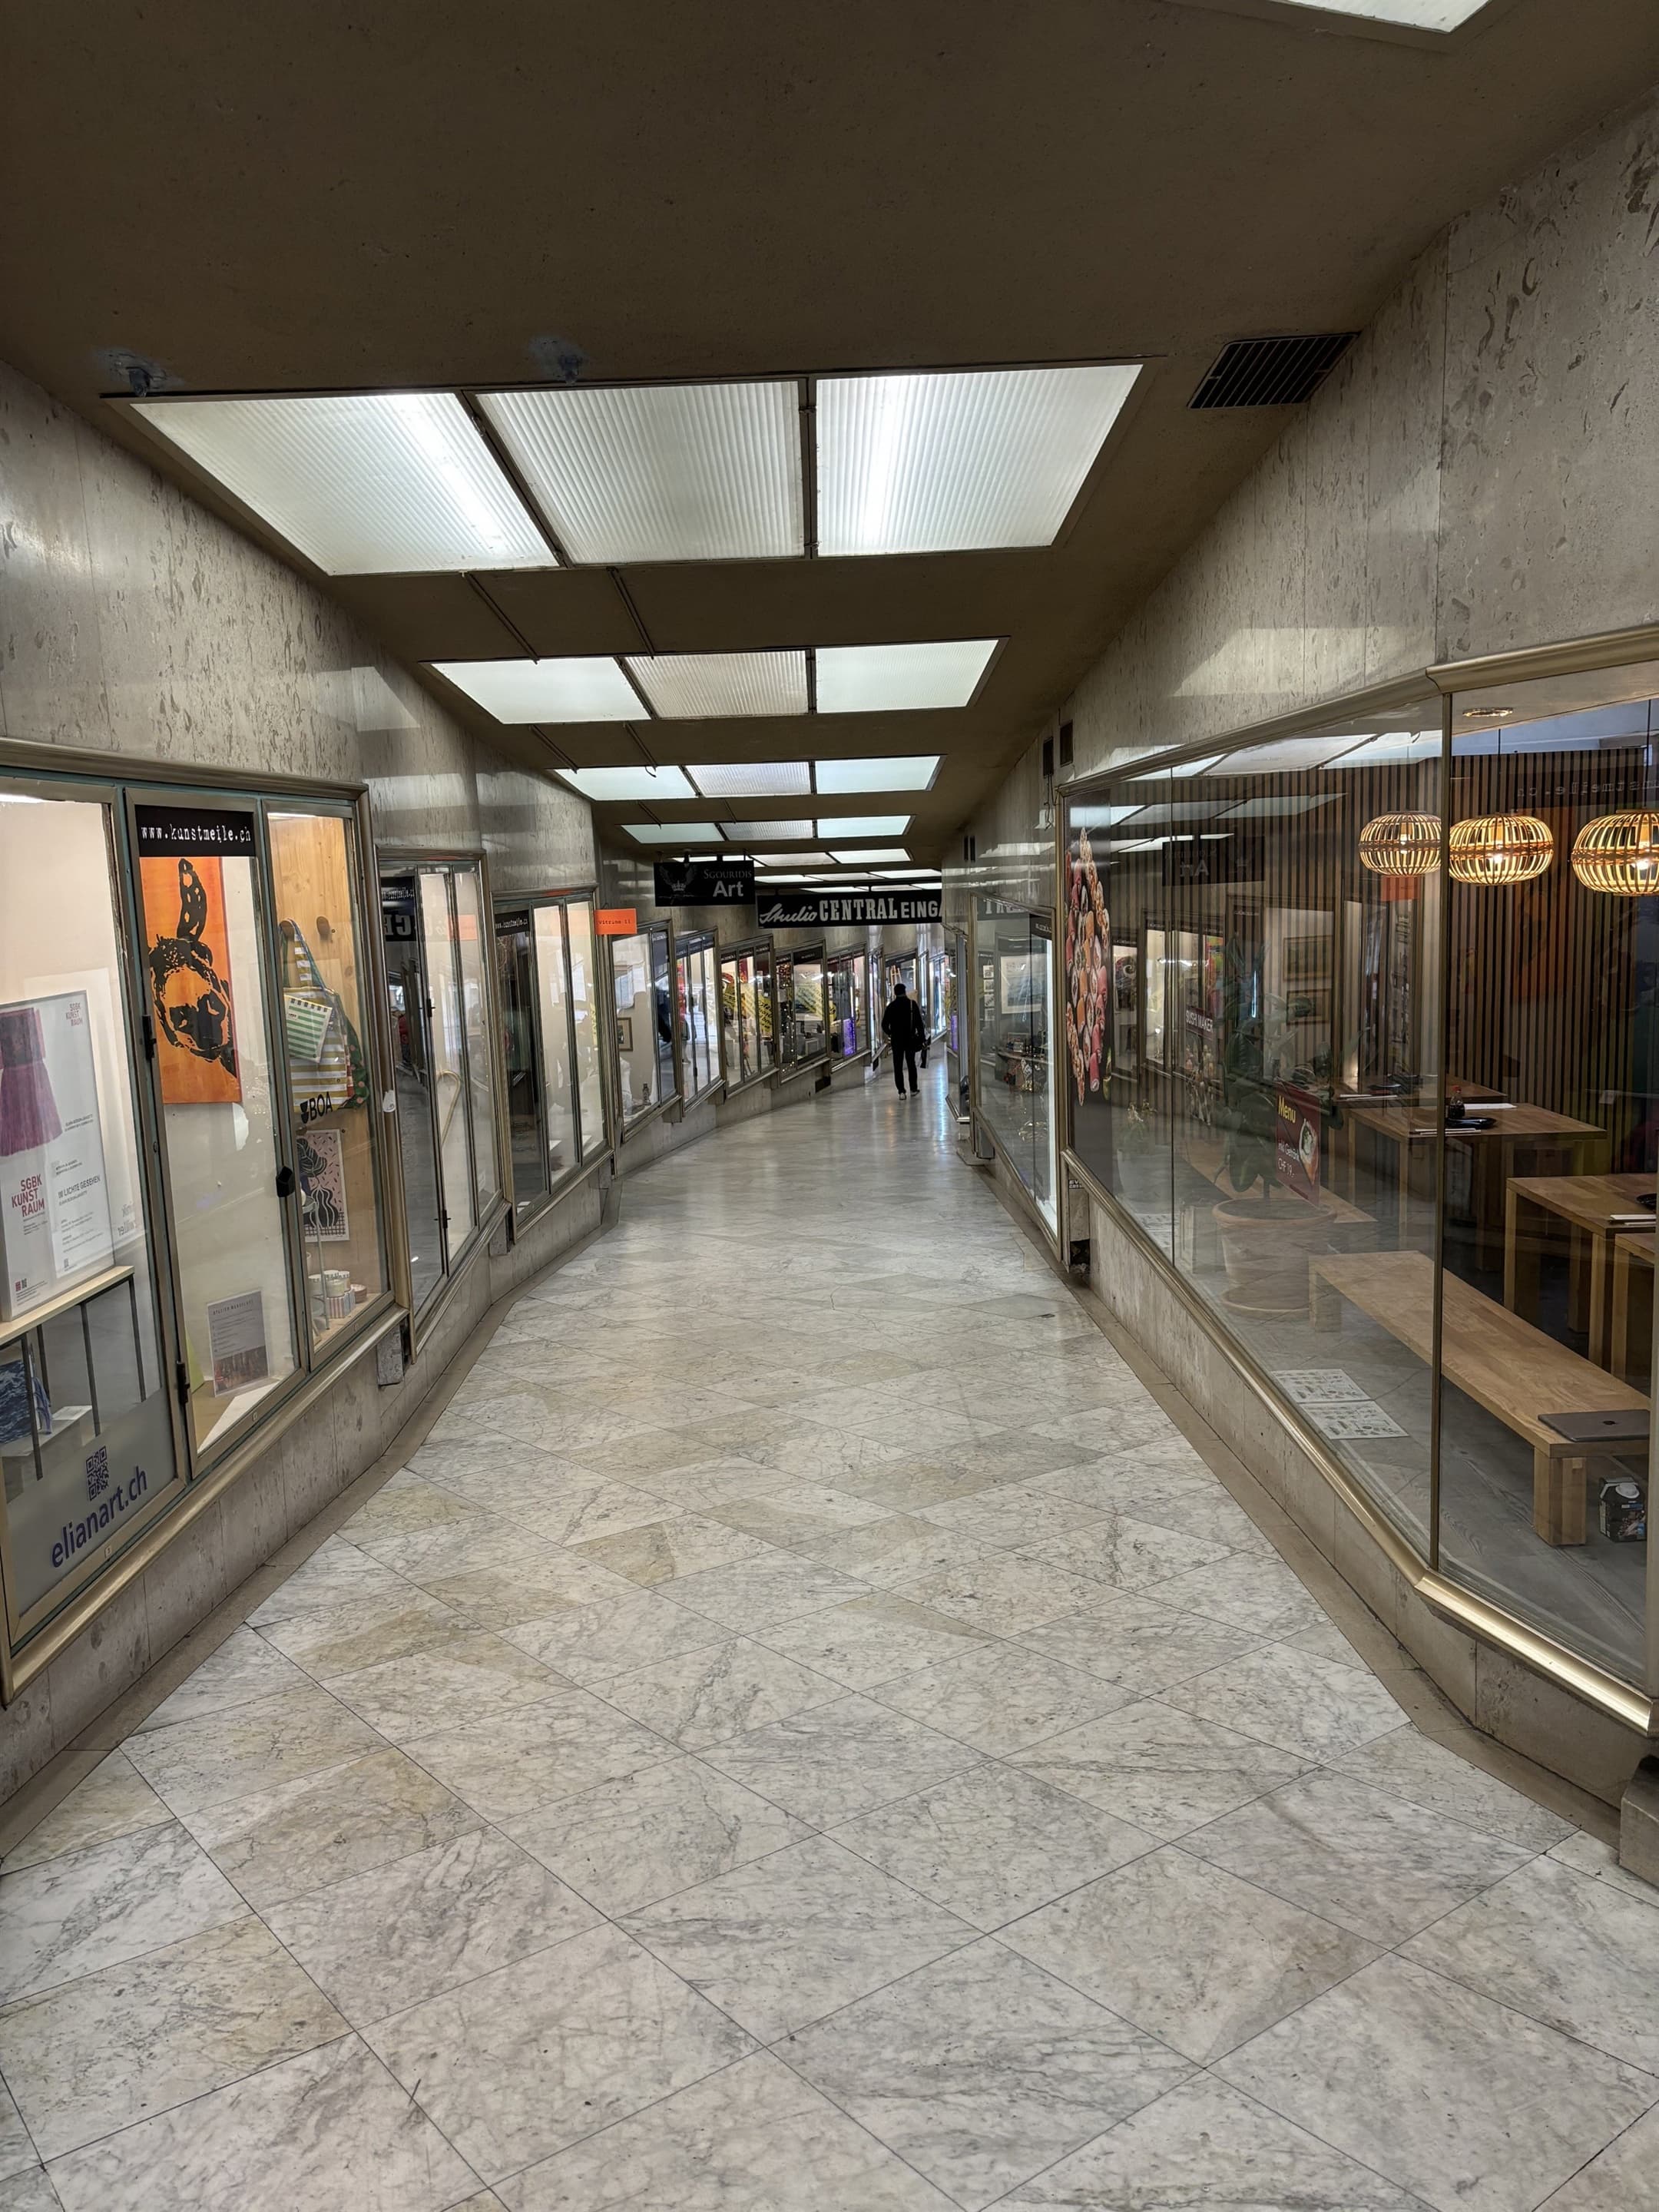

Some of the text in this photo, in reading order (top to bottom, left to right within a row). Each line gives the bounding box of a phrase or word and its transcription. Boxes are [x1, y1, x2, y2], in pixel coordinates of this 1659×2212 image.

[141, 823, 251, 843] www.kunstmeile.ch
[712, 880, 744, 898] Art
[759, 902, 818, 924] Studio
[819, 897, 898, 922] CENTRAL
[1278, 1094, 1296, 1124] Menu
[20, 1173, 42, 1192] SGBK
[12, 1187, 38, 1208] KUNST
[21, 1197, 45, 1217] RAUM
[51, 1465, 147, 1568] elianart.ch
